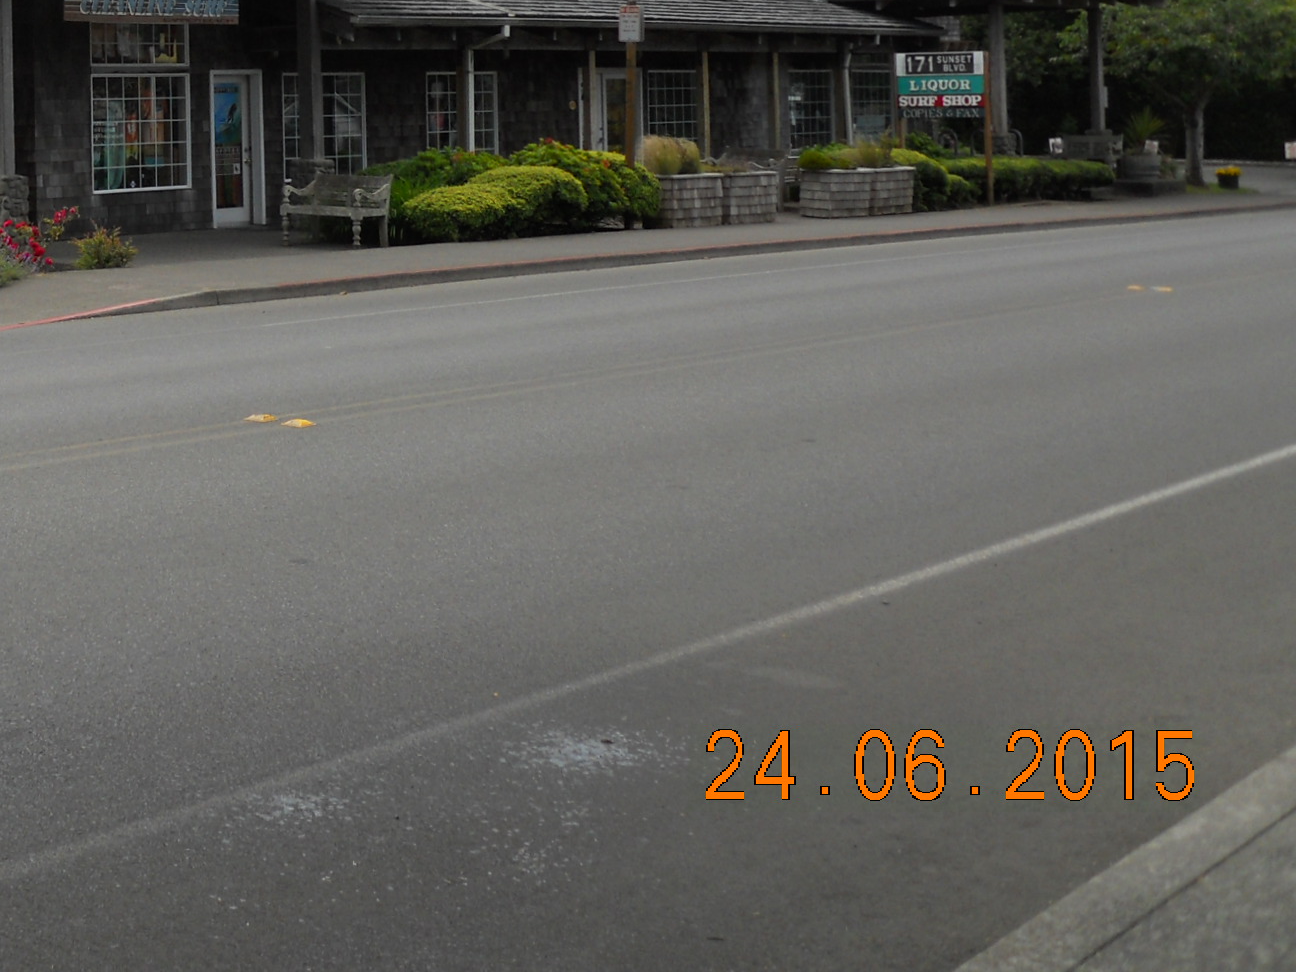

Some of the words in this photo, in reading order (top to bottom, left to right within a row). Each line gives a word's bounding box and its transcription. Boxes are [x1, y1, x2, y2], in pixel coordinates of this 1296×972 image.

[907, 56, 934, 73] 171
[936, 55, 973, 64] SUNSET
[909, 79, 971, 92] LIQUOR
[898, 95, 938, 107] SURF
[942, 94, 982, 106] SHOP
[903, 108, 943, 118] COPIES
[956, 108, 980, 118] FAX
